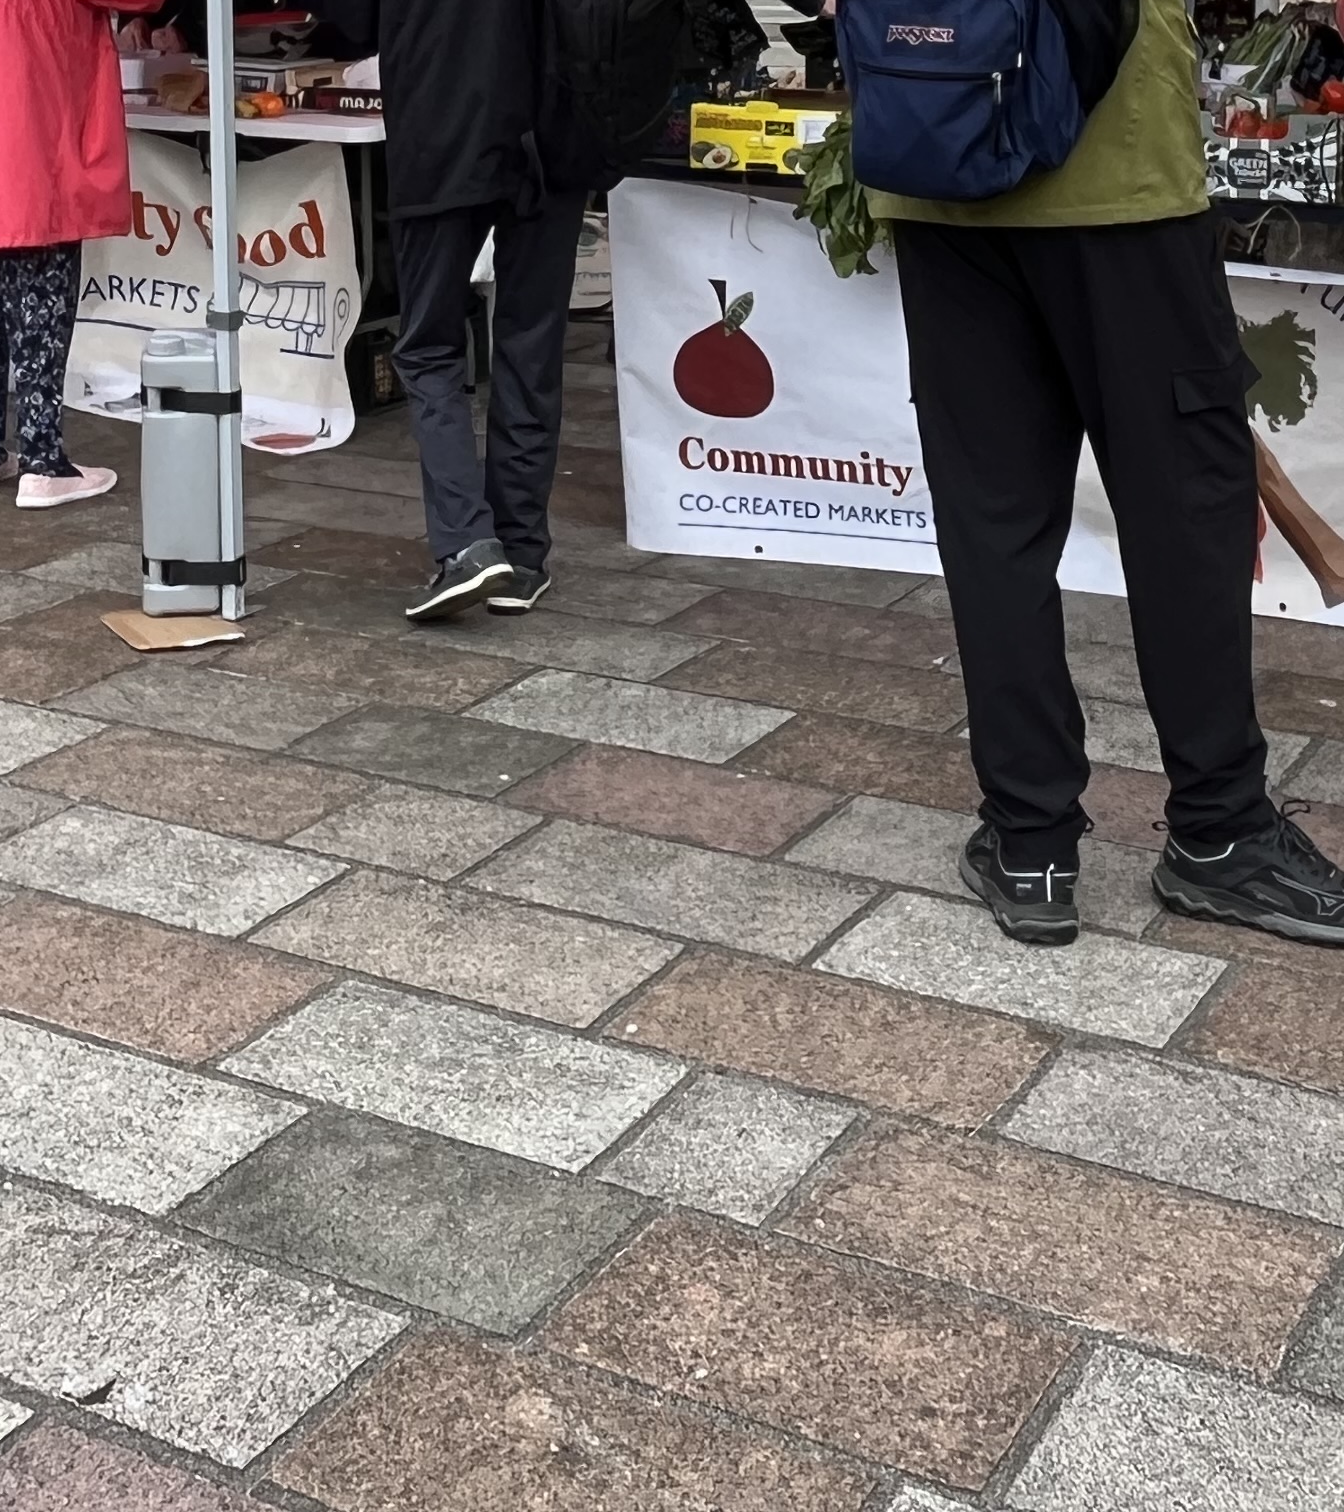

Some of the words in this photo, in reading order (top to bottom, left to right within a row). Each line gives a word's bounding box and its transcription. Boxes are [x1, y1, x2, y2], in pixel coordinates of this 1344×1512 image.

[80, 274, 201, 314] ARKETS
[677, 435, 914, 498] Community
[679, 492, 821, 521] CO-CREATED
[827, 504, 928, 529] MARKETS
